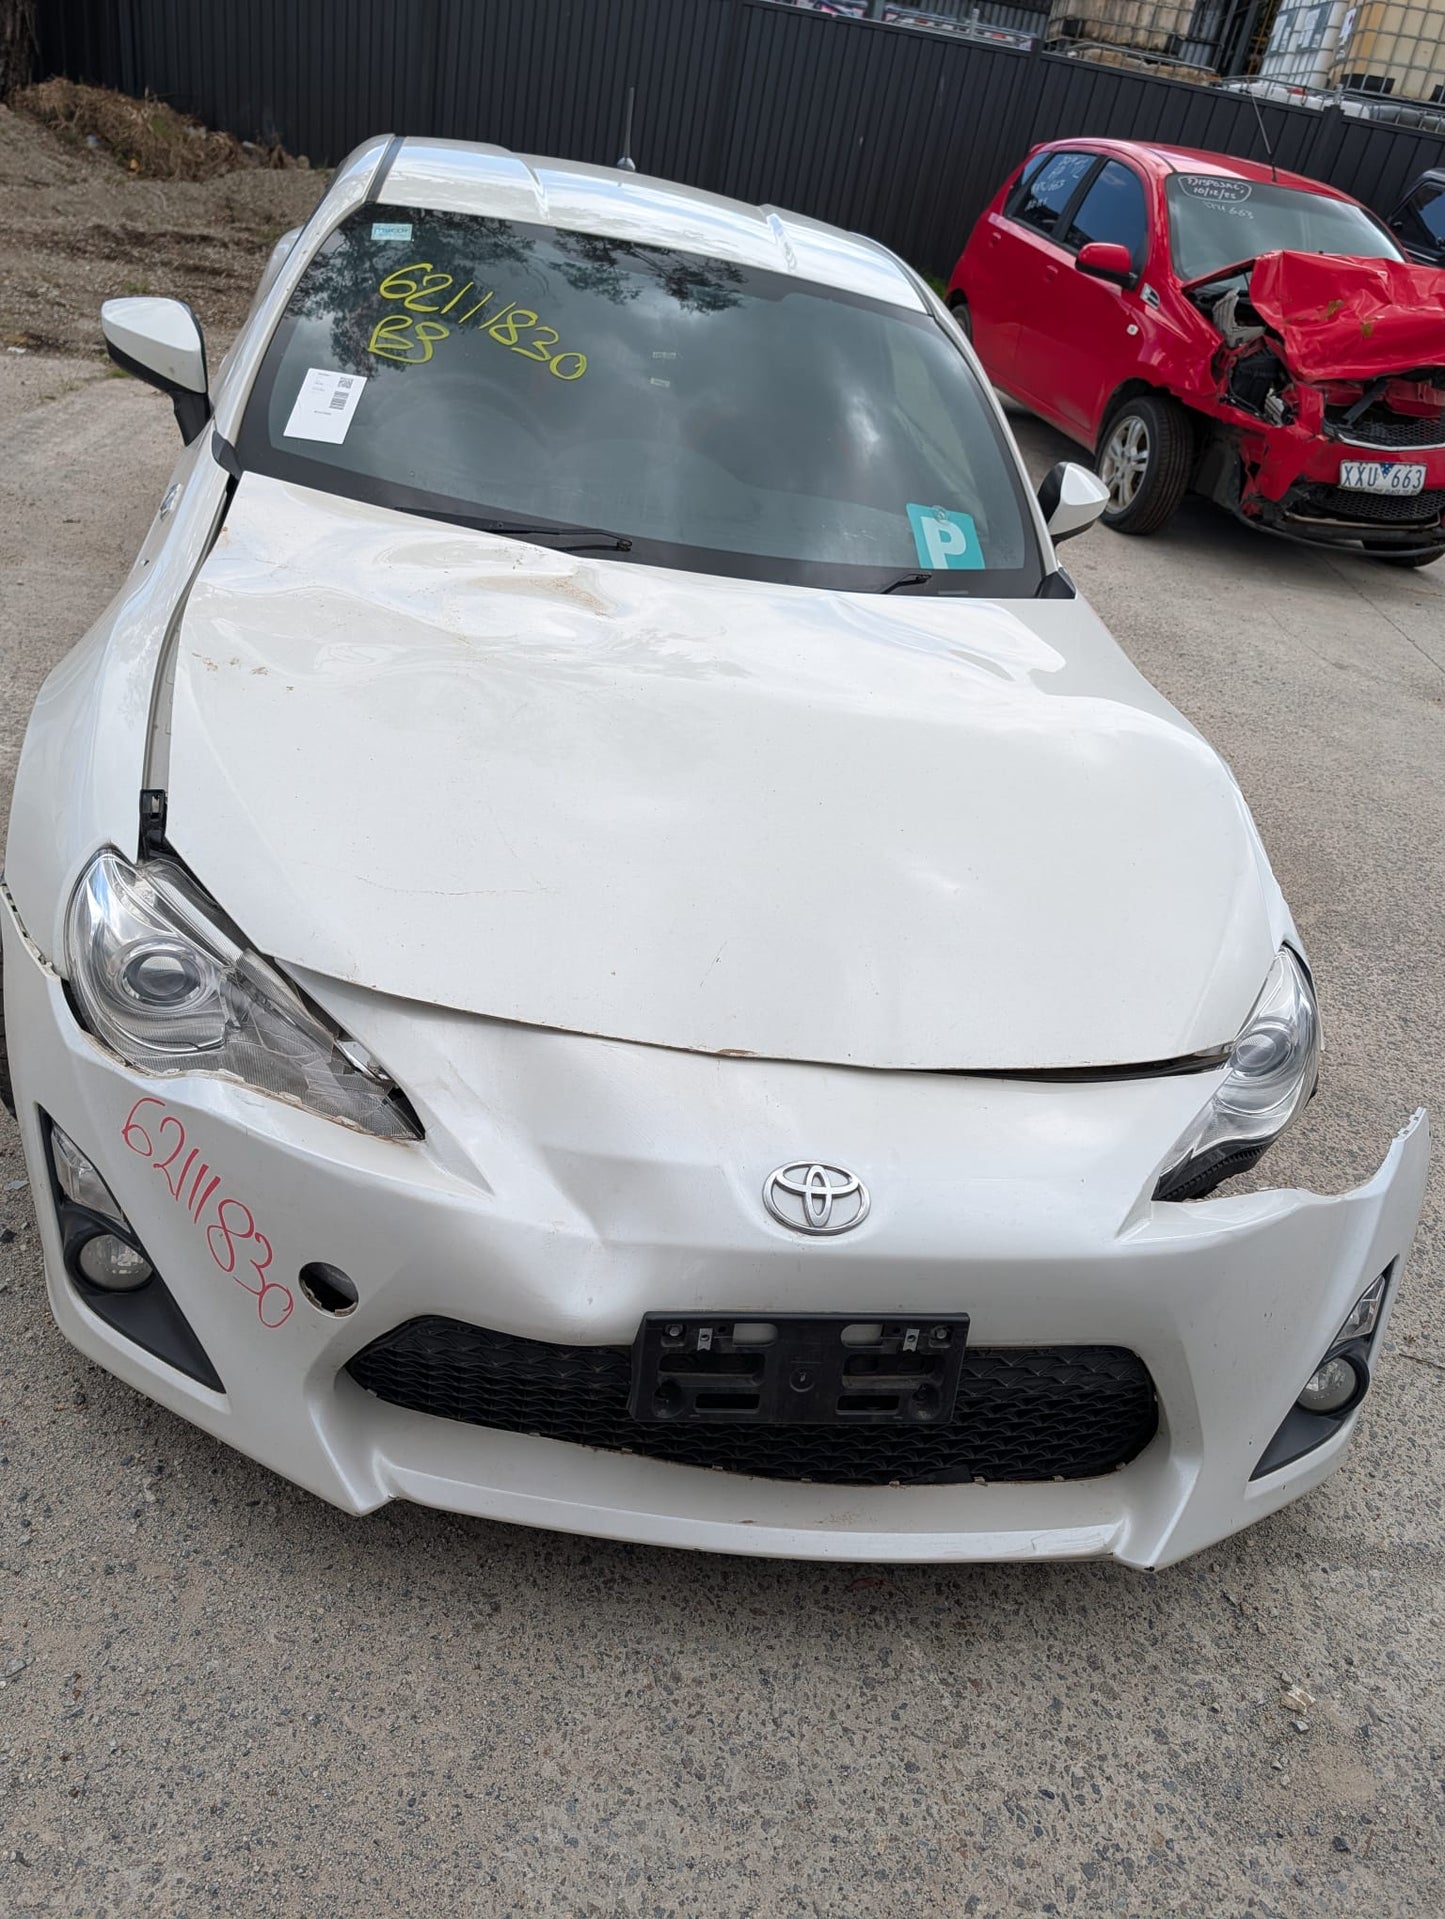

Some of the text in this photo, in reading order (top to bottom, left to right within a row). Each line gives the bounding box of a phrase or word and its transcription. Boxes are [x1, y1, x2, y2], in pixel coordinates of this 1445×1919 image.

[379, 262, 588, 381] 62111830
[1343, 465, 1423, 490] XXU 663
[920, 515, 967, 570] P
[121, 1097, 295, 1329] 62111830
